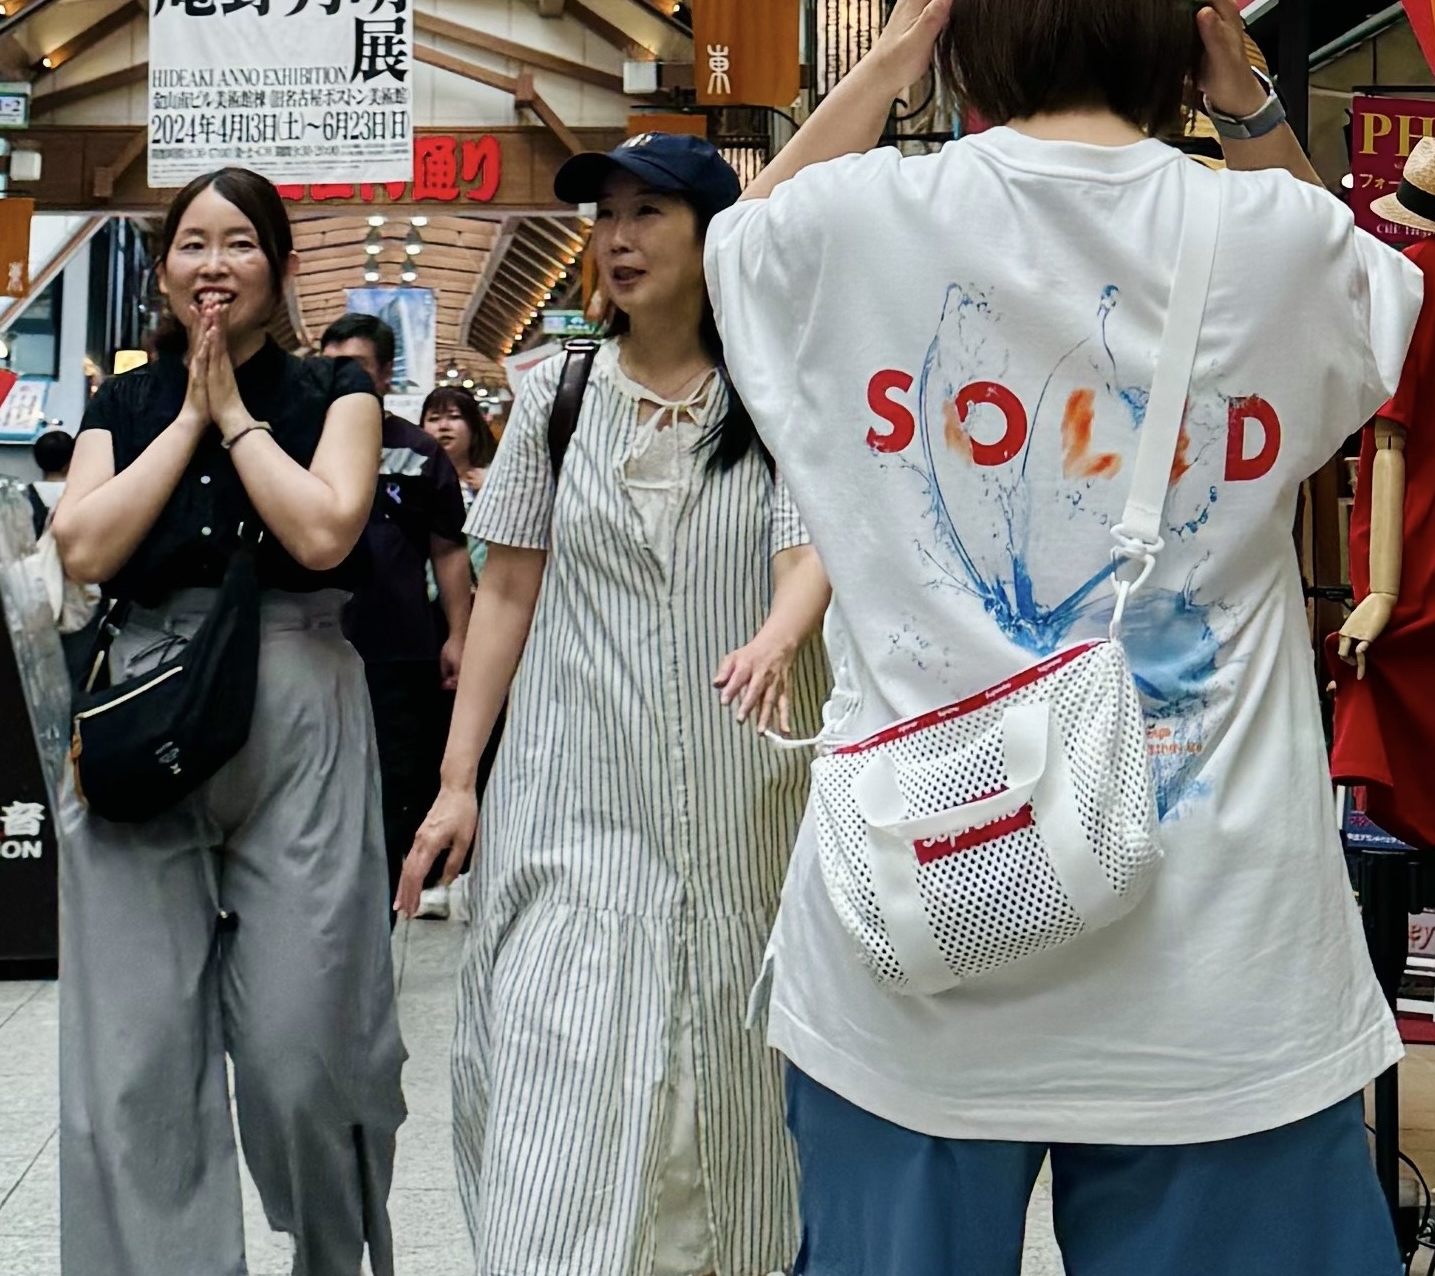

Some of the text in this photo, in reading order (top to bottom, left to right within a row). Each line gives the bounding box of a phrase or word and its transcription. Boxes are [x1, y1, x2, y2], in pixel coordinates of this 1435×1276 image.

[351, 16, 408, 83] 展
[152, 65, 348, 89] HIDEAKI ANNO EXHIBITION
[0, 840, 43, 859] ON
